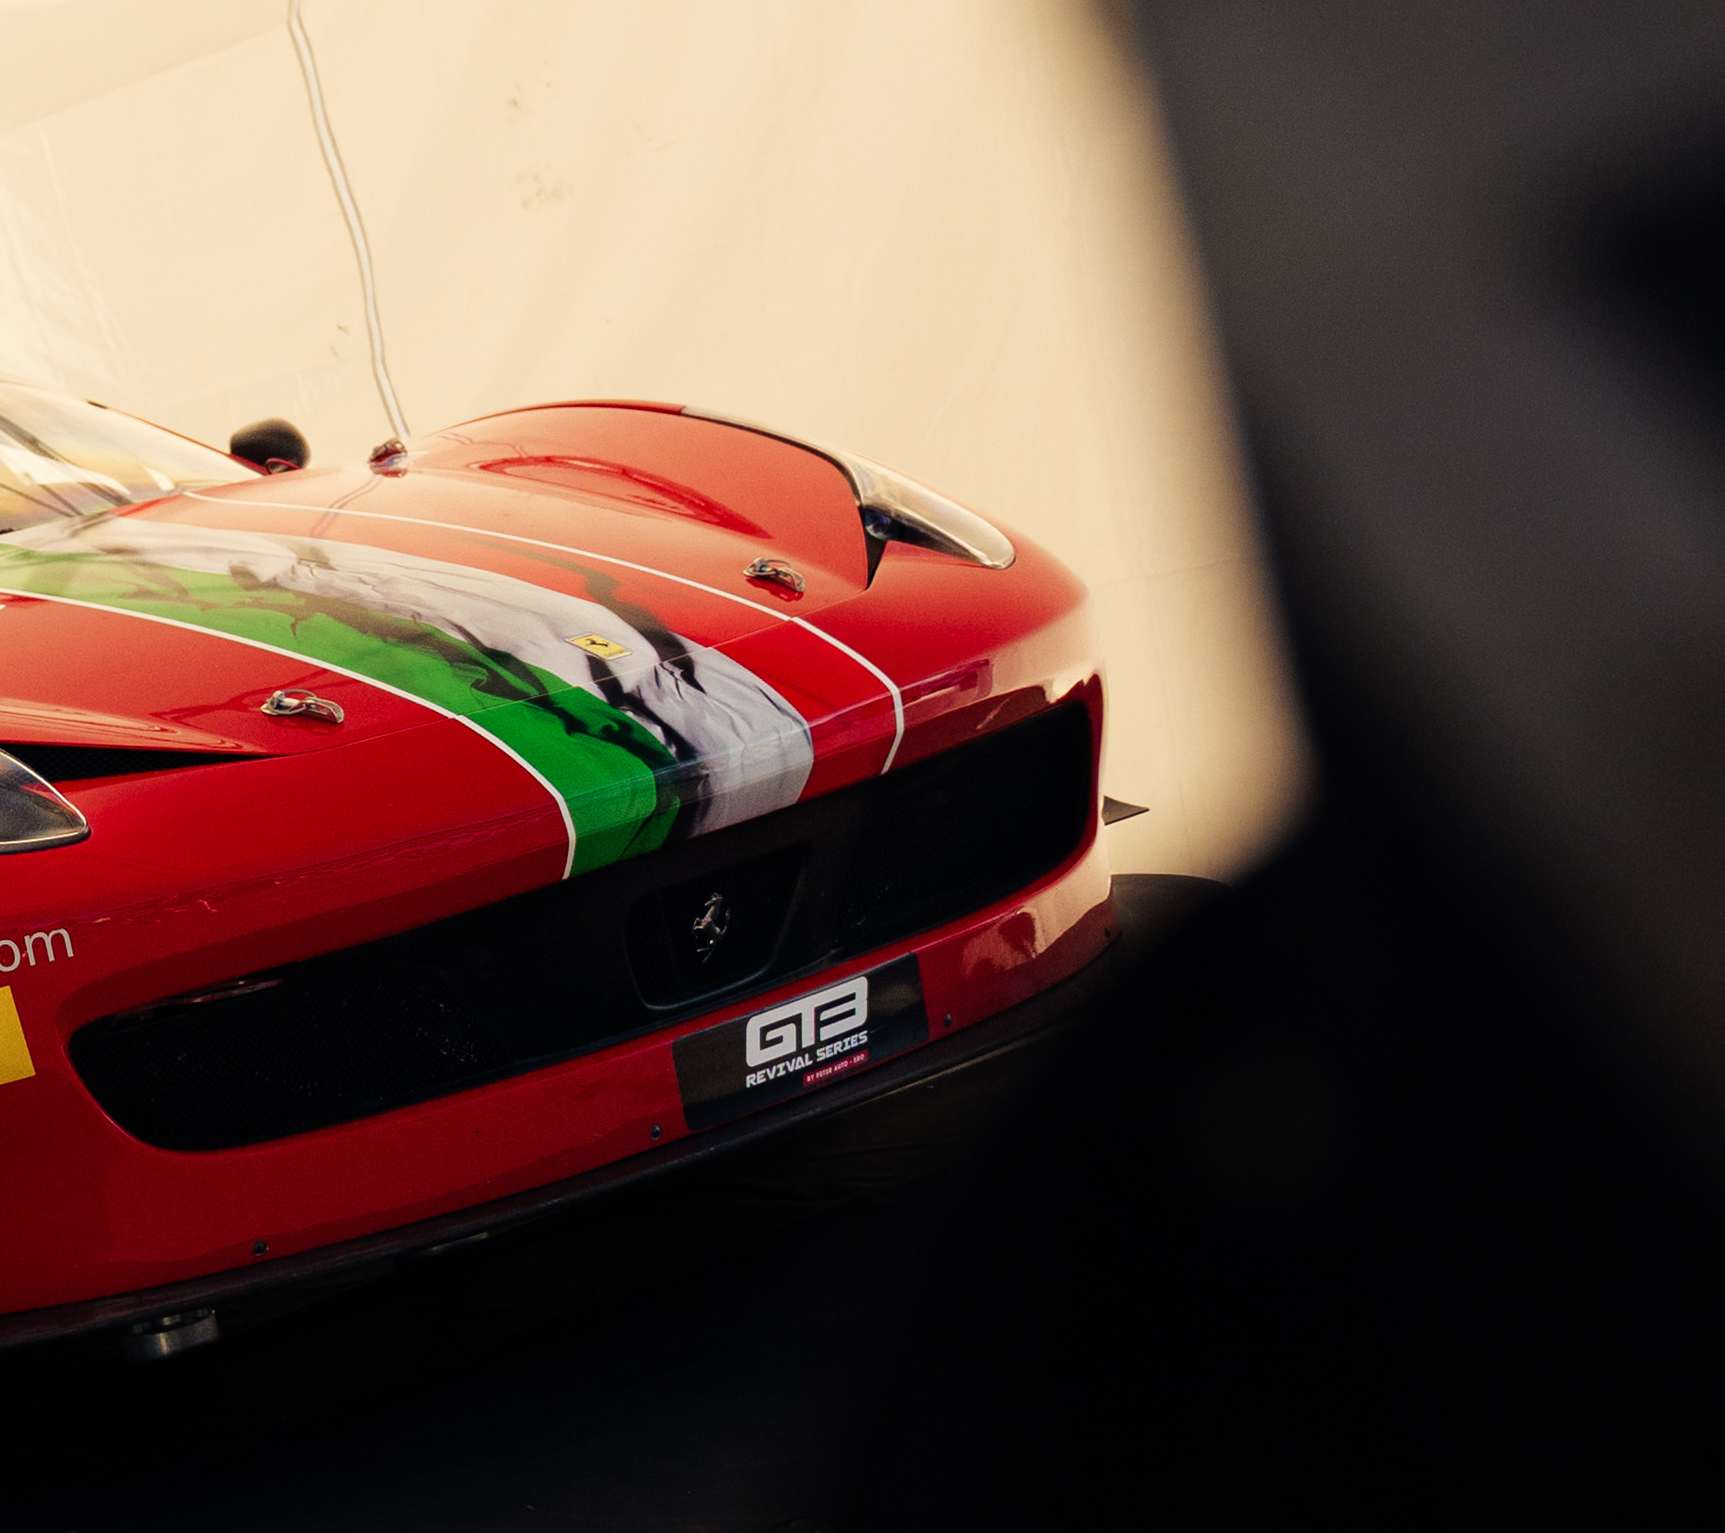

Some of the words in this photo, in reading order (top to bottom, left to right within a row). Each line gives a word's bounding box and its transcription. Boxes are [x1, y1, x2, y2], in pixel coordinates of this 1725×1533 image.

[746, 976, 868, 1067] GT3
[746, 1053, 813, 1088] REVIVAL
[816, 1030, 868, 1061] SERIES
[815, 1067, 832, 1079] PETER
[834, 1060, 849, 1072] AUTO
